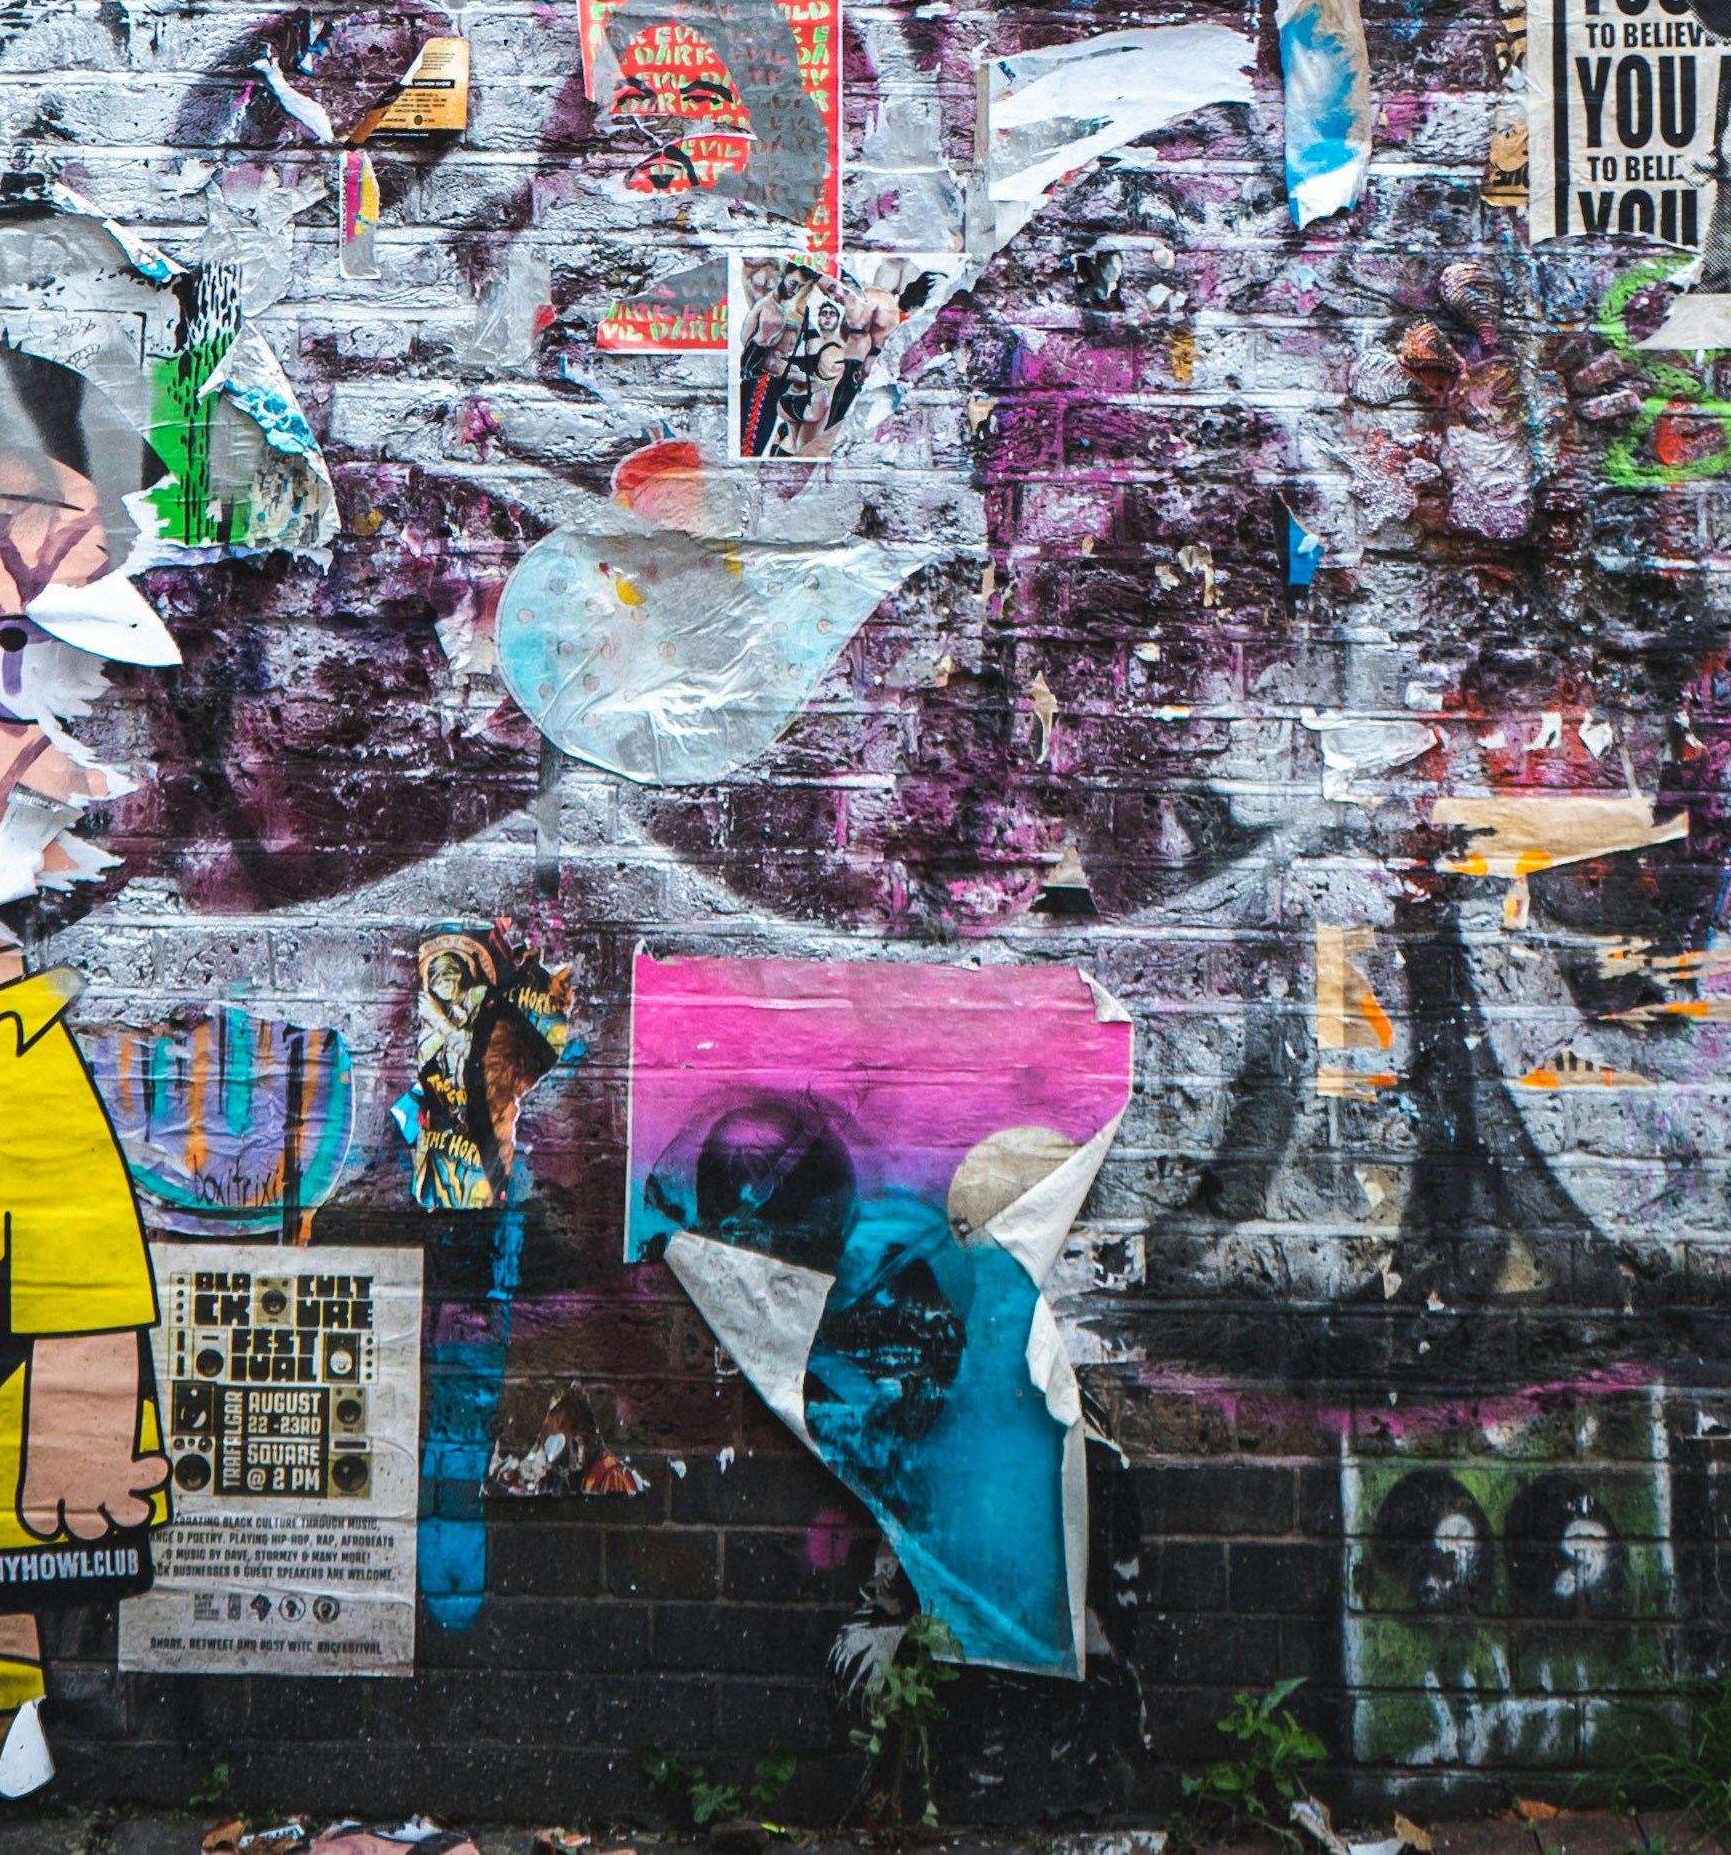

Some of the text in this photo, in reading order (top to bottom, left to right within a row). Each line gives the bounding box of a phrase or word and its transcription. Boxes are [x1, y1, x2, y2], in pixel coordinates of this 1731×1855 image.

[1585, 23, 1615, 49] TO
[1623, 22, 1711, 48] BELIEV
[1576, 54, 1697, 149] YOU
[1587, 156, 1617, 182] TO
[248, 1391, 322, 1415] AUGUST
[247, 1415, 269, 1434] 22
[222, 1390, 244, 1489] TRAFALGAR
[247, 1444, 320, 1466] SQUARE
[247, 1468, 320, 1492] @ 2 PM
[222, 1516, 253, 1528] BLACK
[255, 1516, 297, 1529] CULTURE
[229, 1533, 268, 1545] PLAYING
[340, 1535, 395, 1548] AFROBEATS
[176, 1549, 206, 1561] MUSIC
[209, 1549, 221, 1560] BY
[254, 1550, 299, 1562] STORMZY
[311, 1550, 338, 1563] MANY
[341, 1551, 371, 1564] MORE!
[173, 1565, 231, 1577] BUSINESSES
[243, 1566, 274, 1578] GUEST
[276, 1567, 324, 1579] SPEAKERS
[326, 1567, 344, 1580] ARE
[188, 1637, 235, 1651] RETWEET
